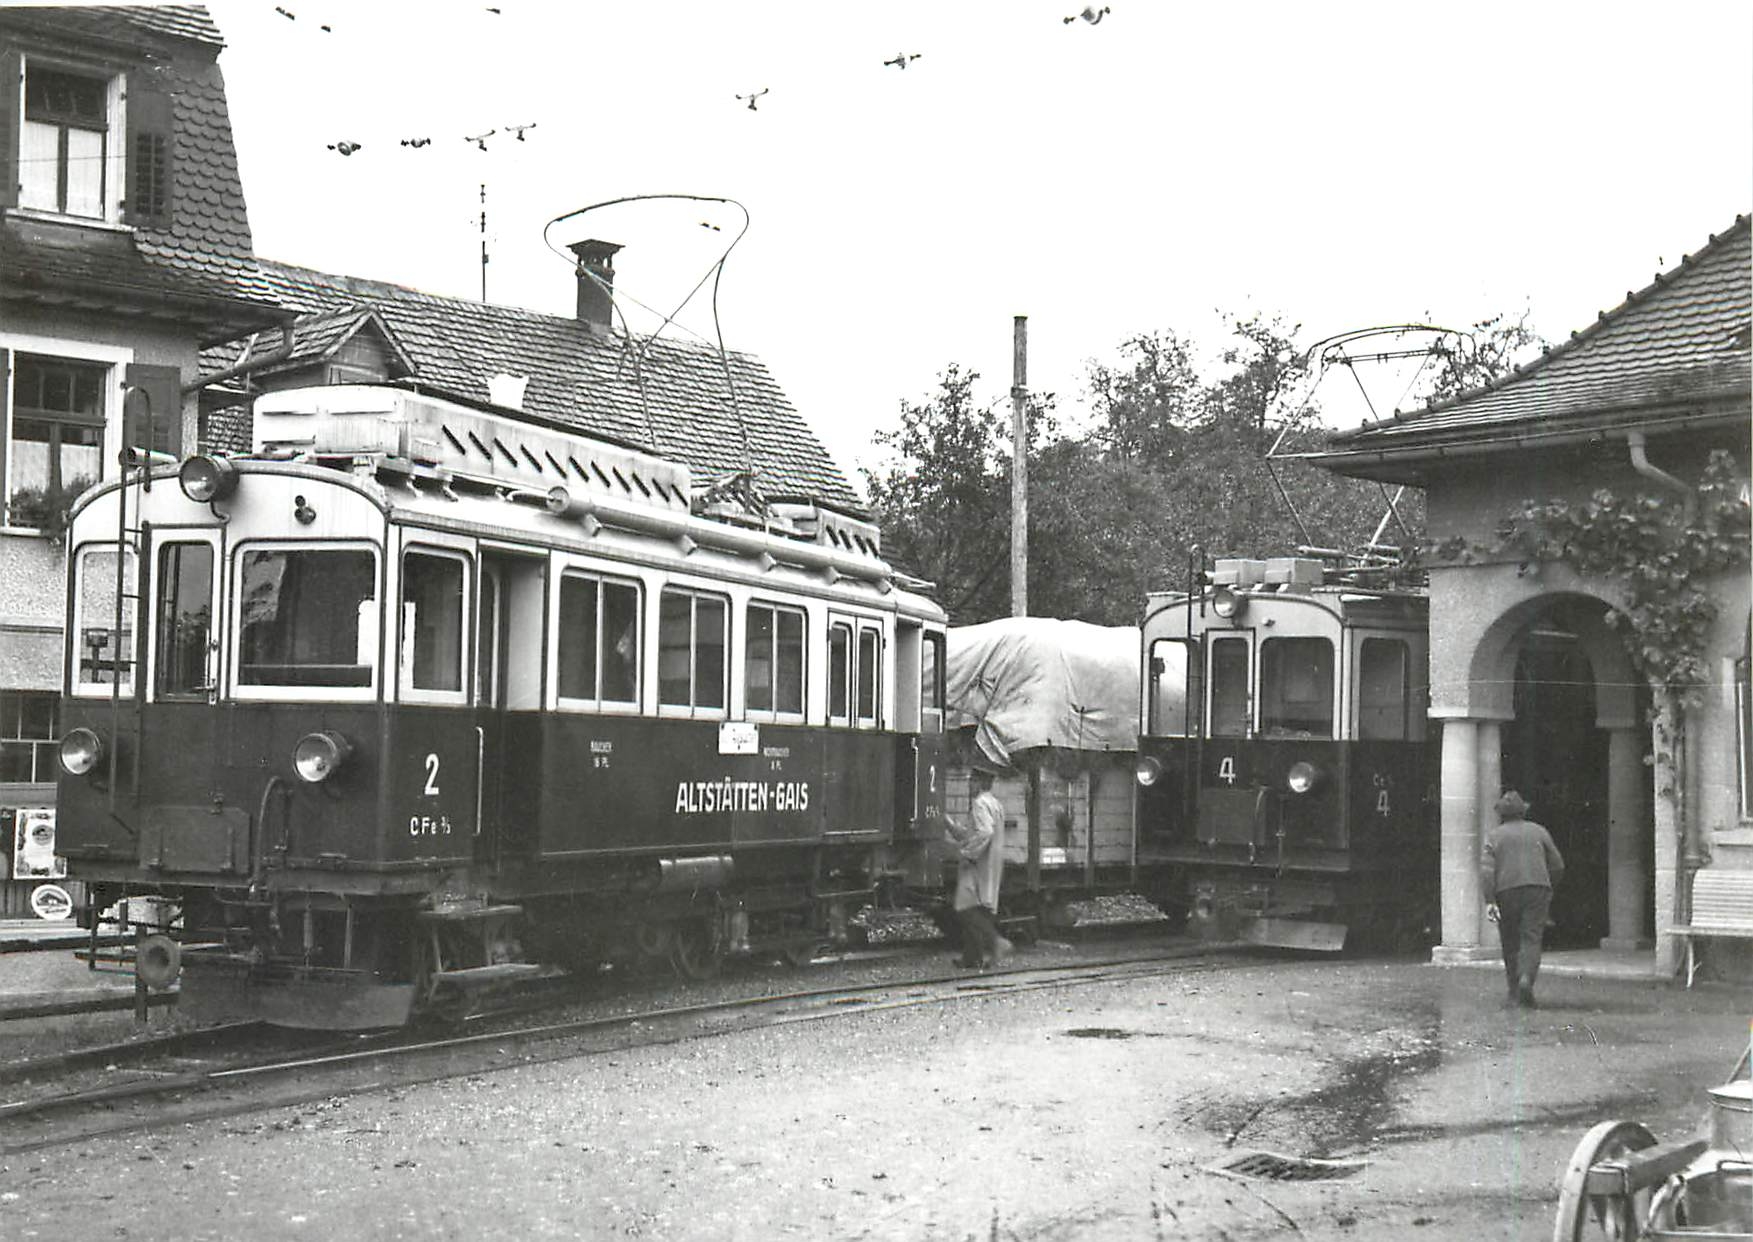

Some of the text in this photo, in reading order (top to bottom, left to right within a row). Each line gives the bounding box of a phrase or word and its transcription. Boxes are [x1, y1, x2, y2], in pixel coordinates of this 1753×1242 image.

[424, 753, 439, 795] 2
[930, 765, 936, 792] 2
[1219, 757, 1236, 784] 4
[675, 776, 808, 813] ALTSTÄTTEN-GAIS
[1377, 790, 1390, 816] 4
[410, 816, 436, 835] CFe
